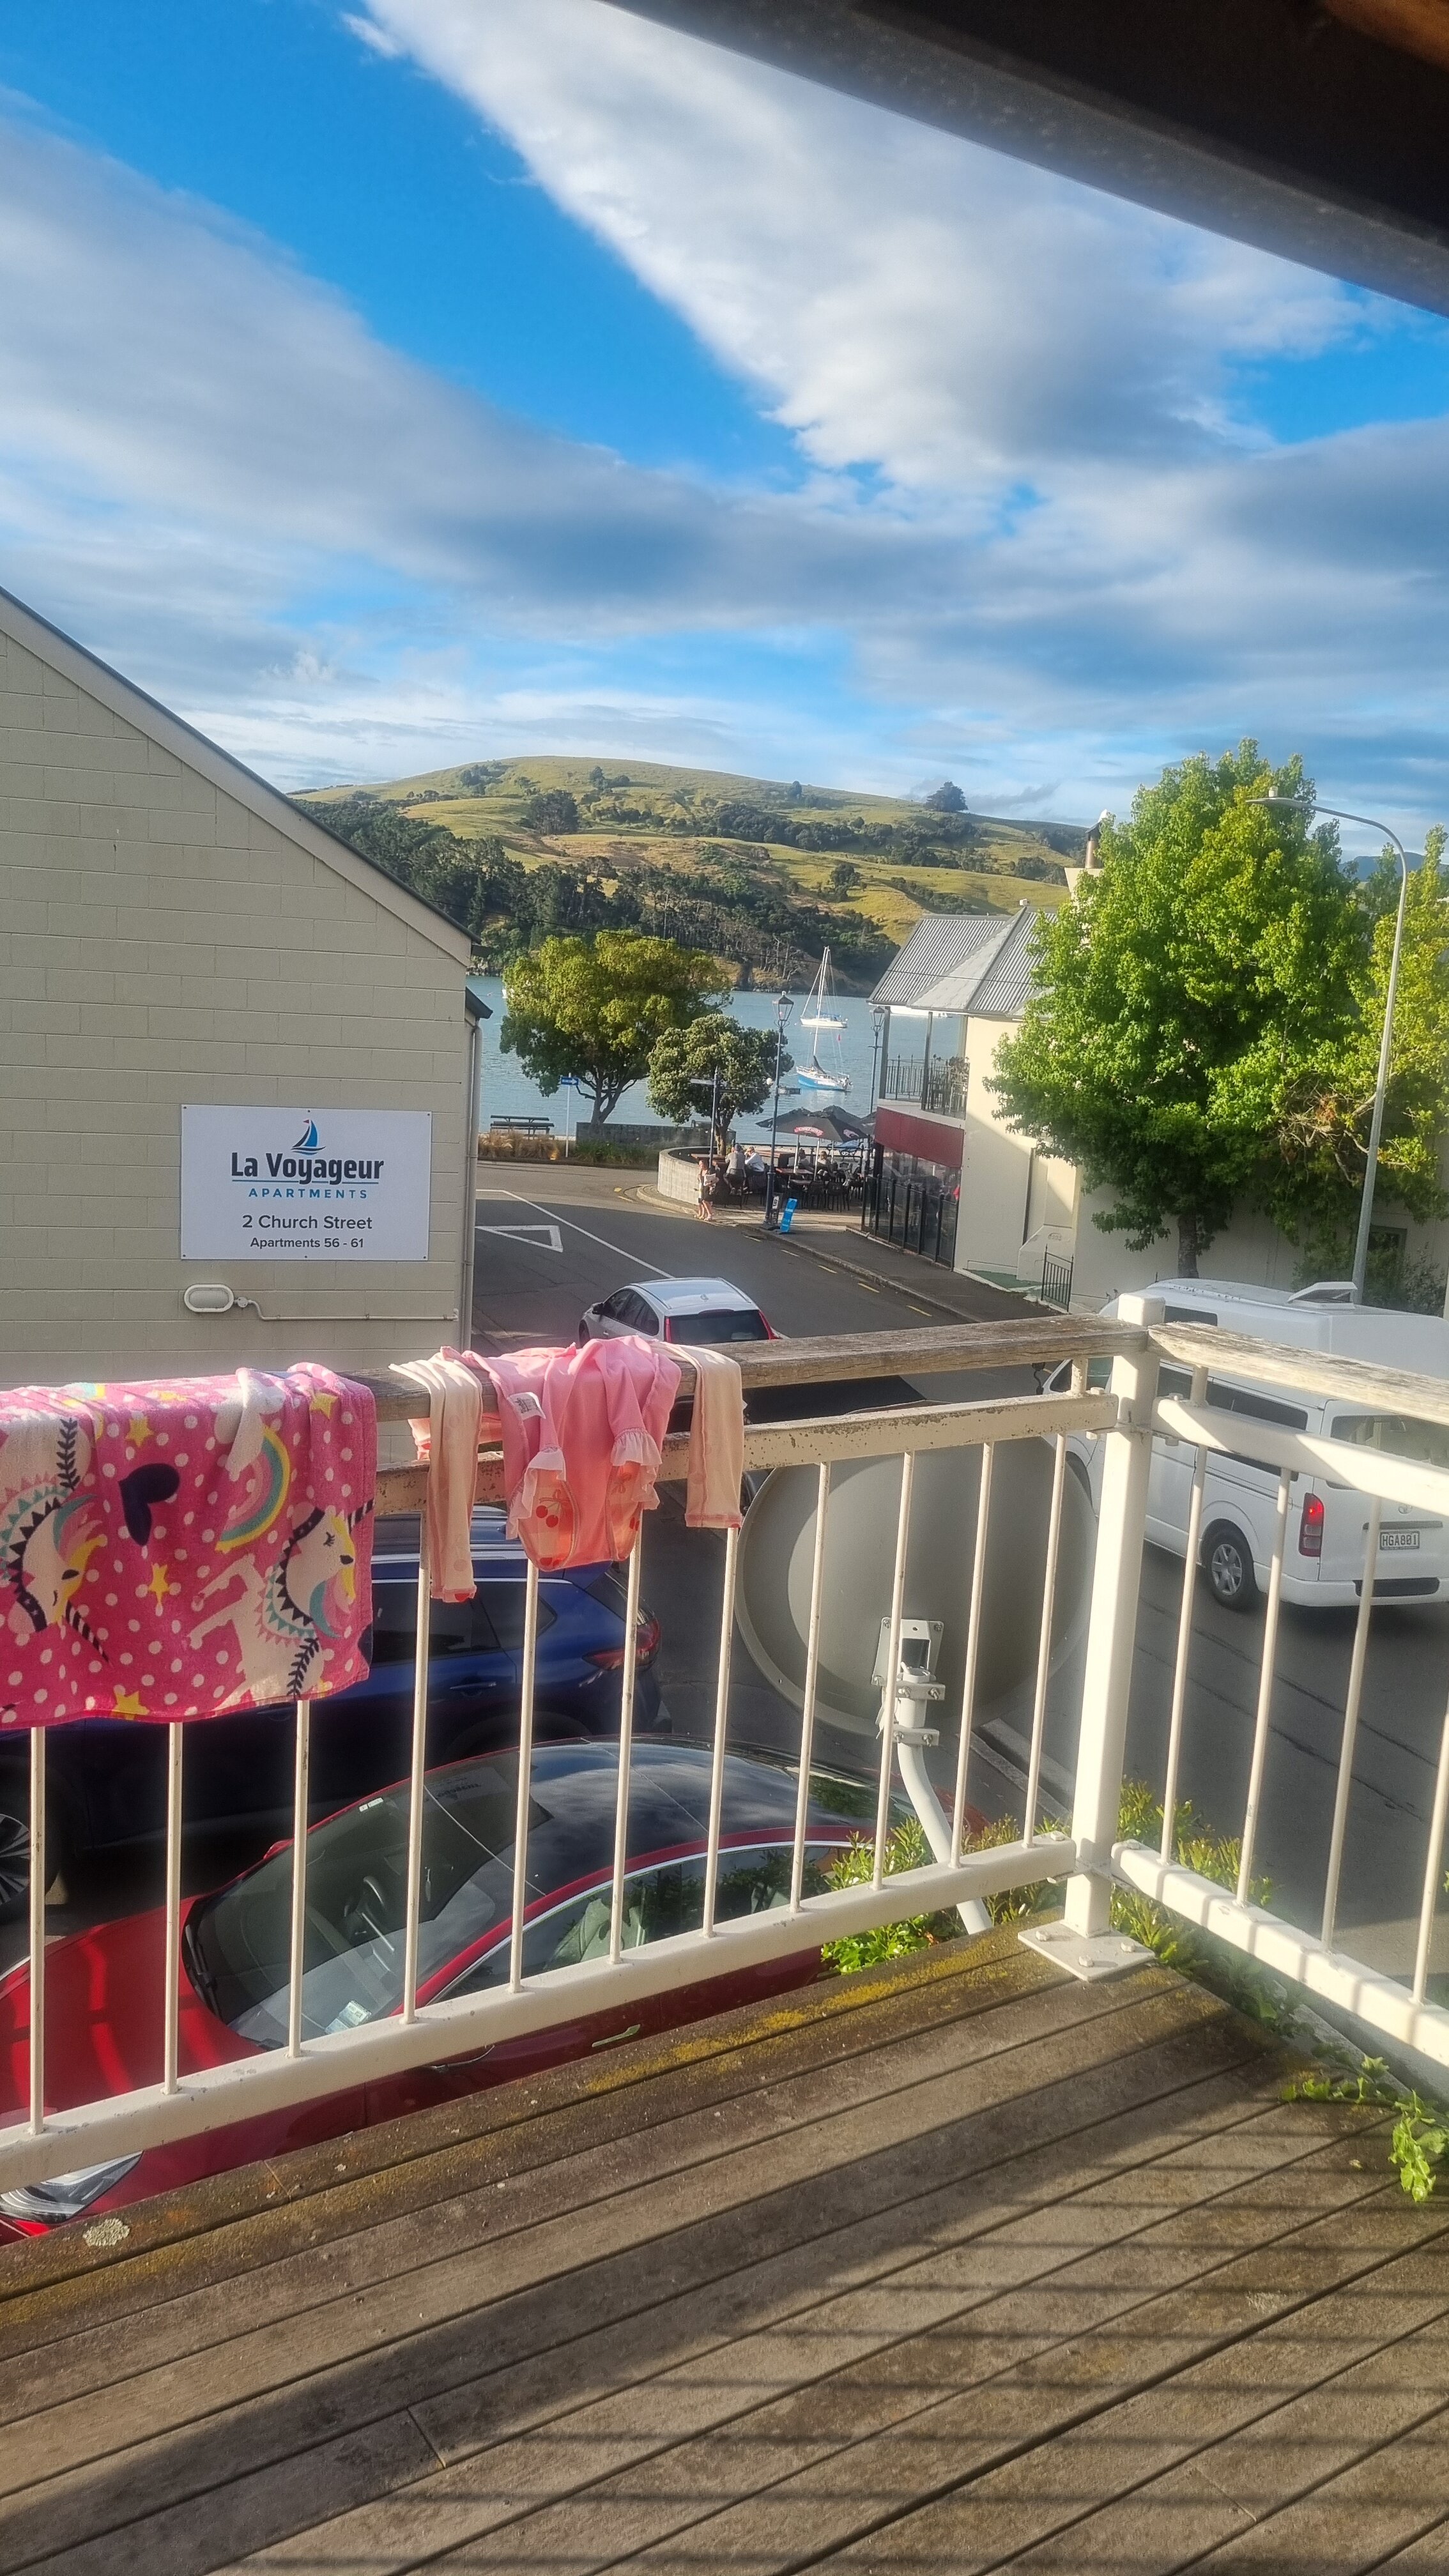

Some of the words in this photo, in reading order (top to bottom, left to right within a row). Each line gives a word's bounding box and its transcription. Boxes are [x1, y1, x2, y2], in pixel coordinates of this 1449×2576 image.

[231, 1152, 258, 1177] La
[266, 1153, 385, 1185] Voyageur
[249, 1188, 367, 1199] APARTMENTS
[242, 1215, 253, 1228] 2
[258, 1215, 318, 1229] Church
[323, 1215, 373, 1229] Street
[250, 1237, 321, 1250] Apartments
[324, 1238, 340, 1248] 56
[350, 1238, 364, 1248] 61
[1382, 1535, 1417, 1546] HGA801
